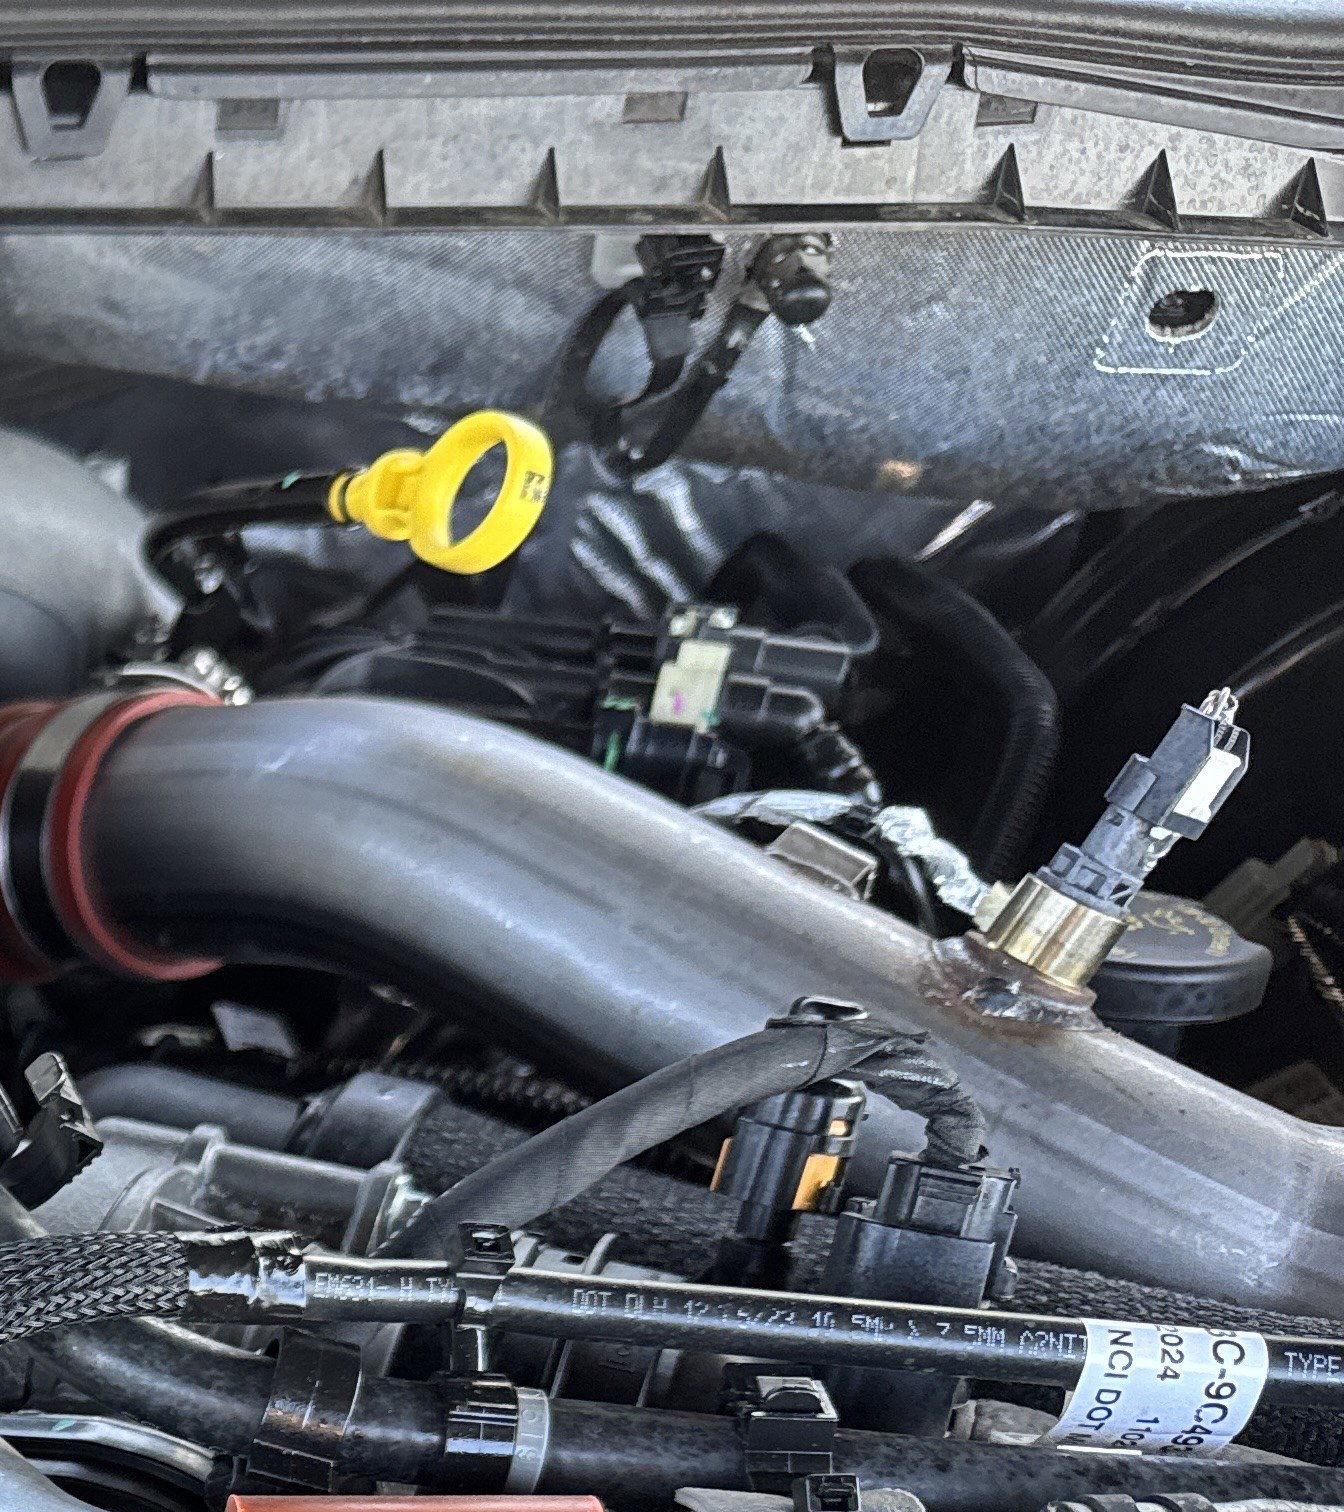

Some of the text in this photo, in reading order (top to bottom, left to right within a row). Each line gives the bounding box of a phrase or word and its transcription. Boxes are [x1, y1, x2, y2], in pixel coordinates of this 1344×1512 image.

[1104, 1329, 1134, 1379] NCI
[1283, 1351, 1342, 1383] TYPE
[1077, 1388, 1122, 1431] DOT
